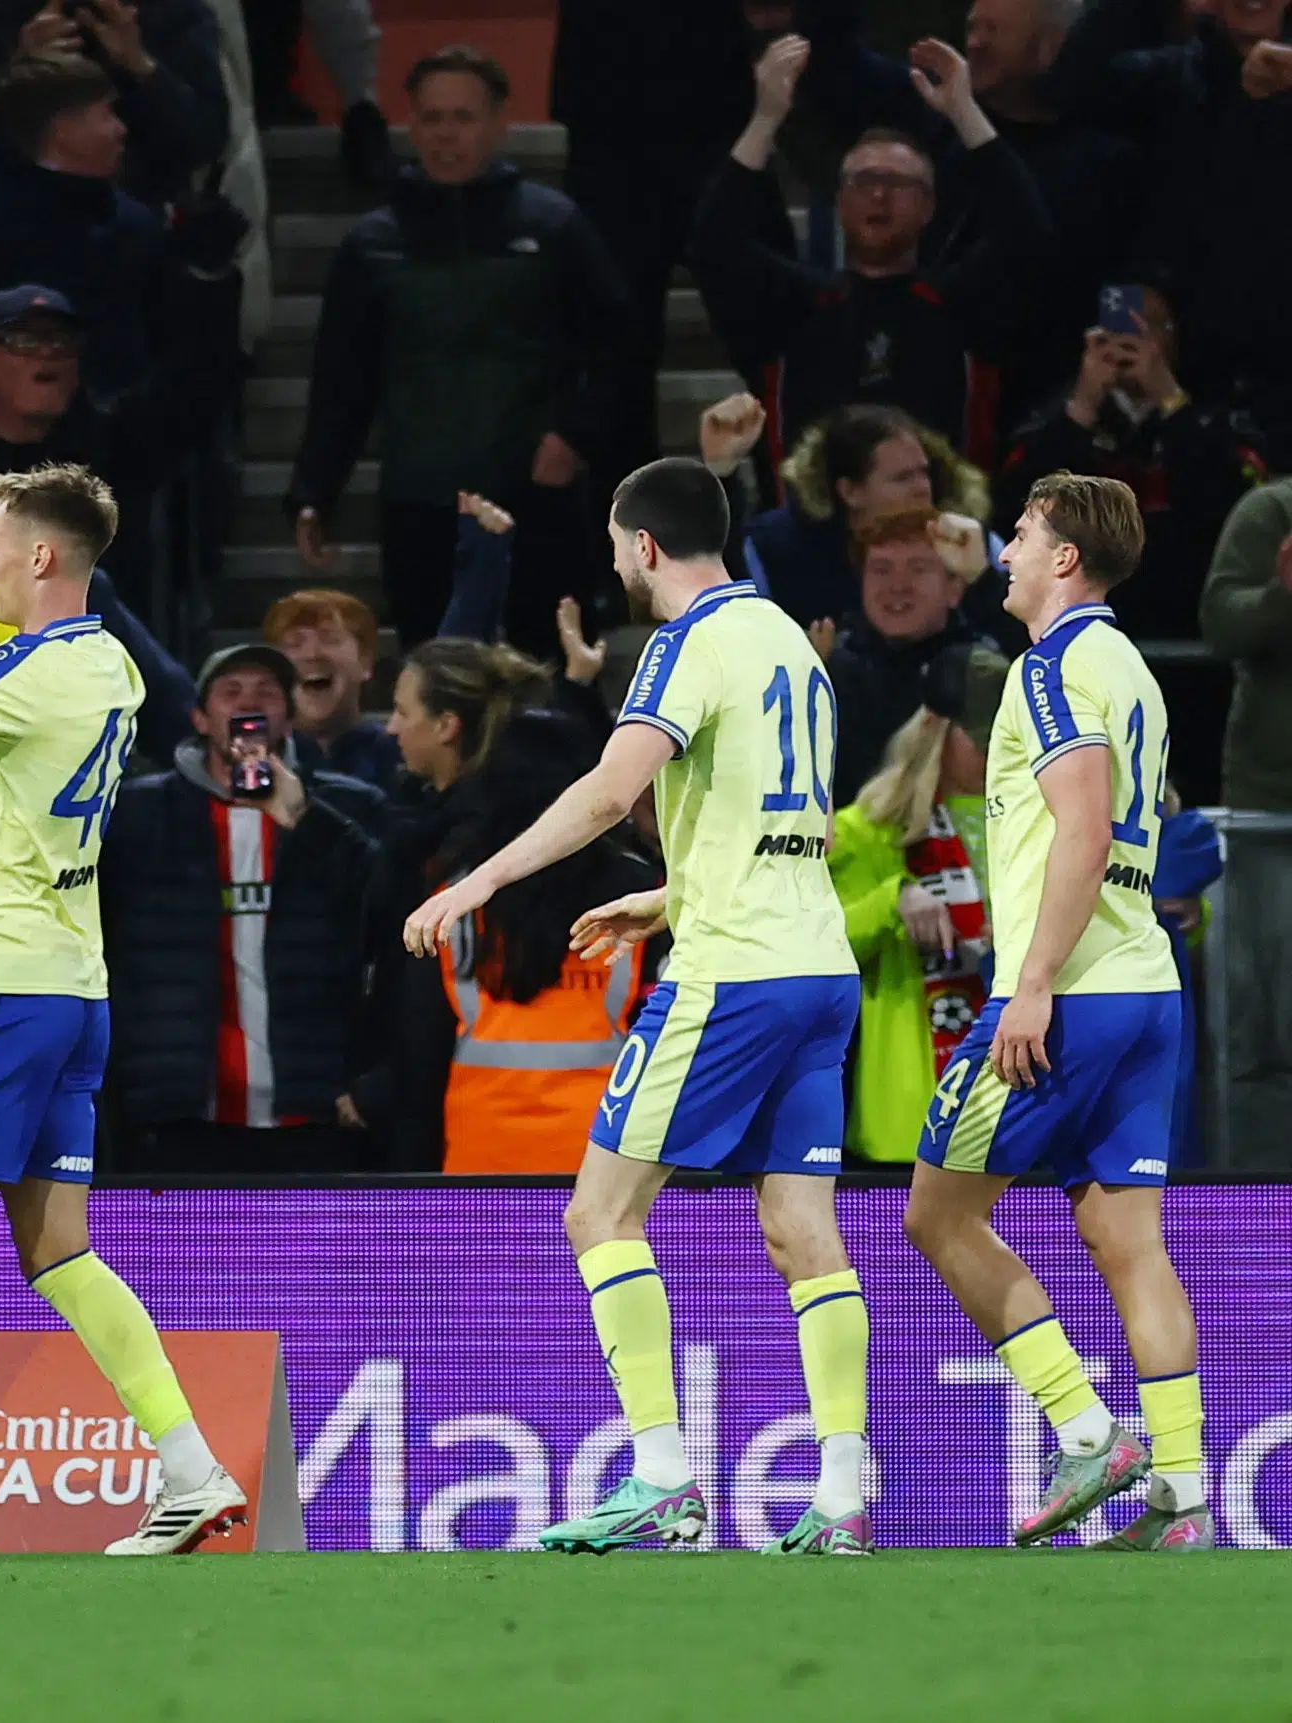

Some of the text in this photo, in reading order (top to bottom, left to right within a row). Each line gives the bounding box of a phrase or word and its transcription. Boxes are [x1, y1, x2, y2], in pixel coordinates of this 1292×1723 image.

[632, 643, 667, 708] GARMIN
[1030, 667, 1062, 743] GARMIN
[761, 665, 838, 816] 10
[608, 1034, 646, 1098] 0
[935, 1058, 971, 1120] 4
